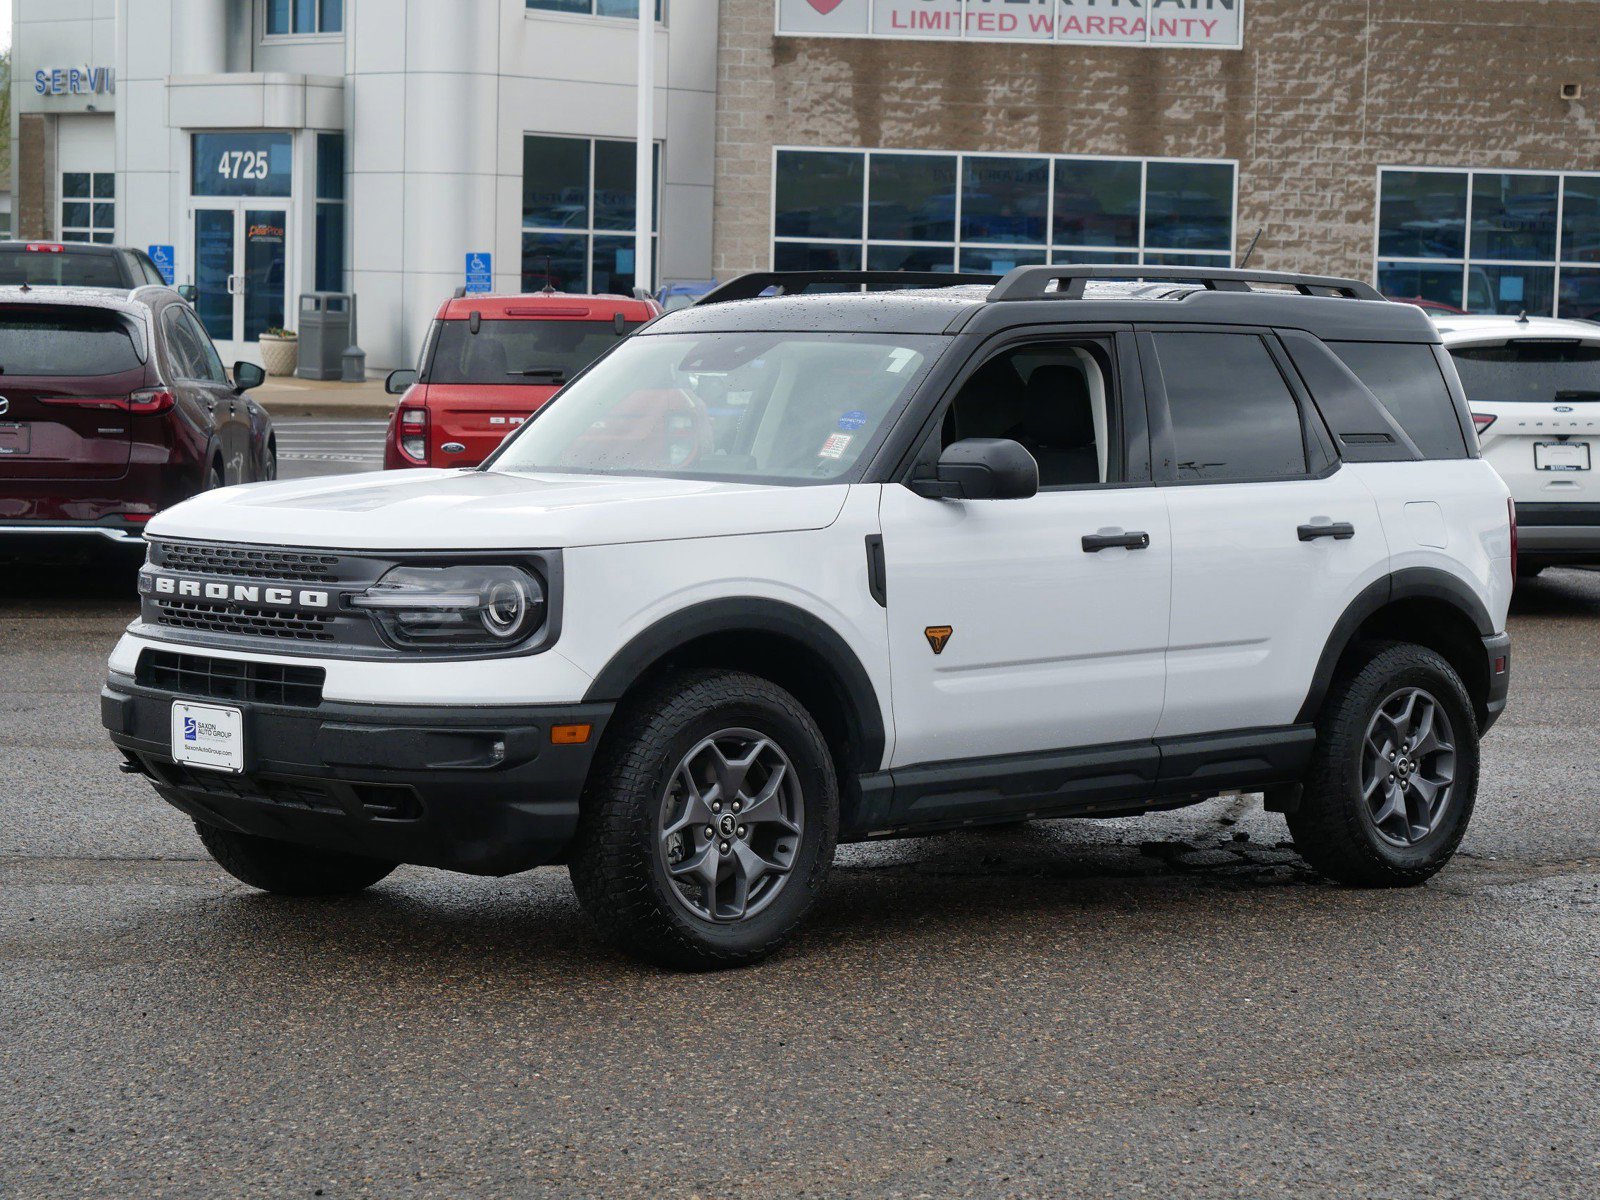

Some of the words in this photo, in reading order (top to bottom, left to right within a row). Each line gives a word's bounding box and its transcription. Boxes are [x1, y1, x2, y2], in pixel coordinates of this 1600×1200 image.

[892, 10, 1018, 32] LIMITED
[1028, 14, 1219, 38] WARRANTY
[34, 67, 110, 95] SERVI
[218, 151, 268, 179] 4725
[156, 577, 328, 608] BRONCO
[197, 728, 212, 736] AUTO
[213, 730, 232, 738] GROUP
[198, 722, 216, 730] SAXON
[185, 745, 232, 756] SaxonAutoGroup.com
